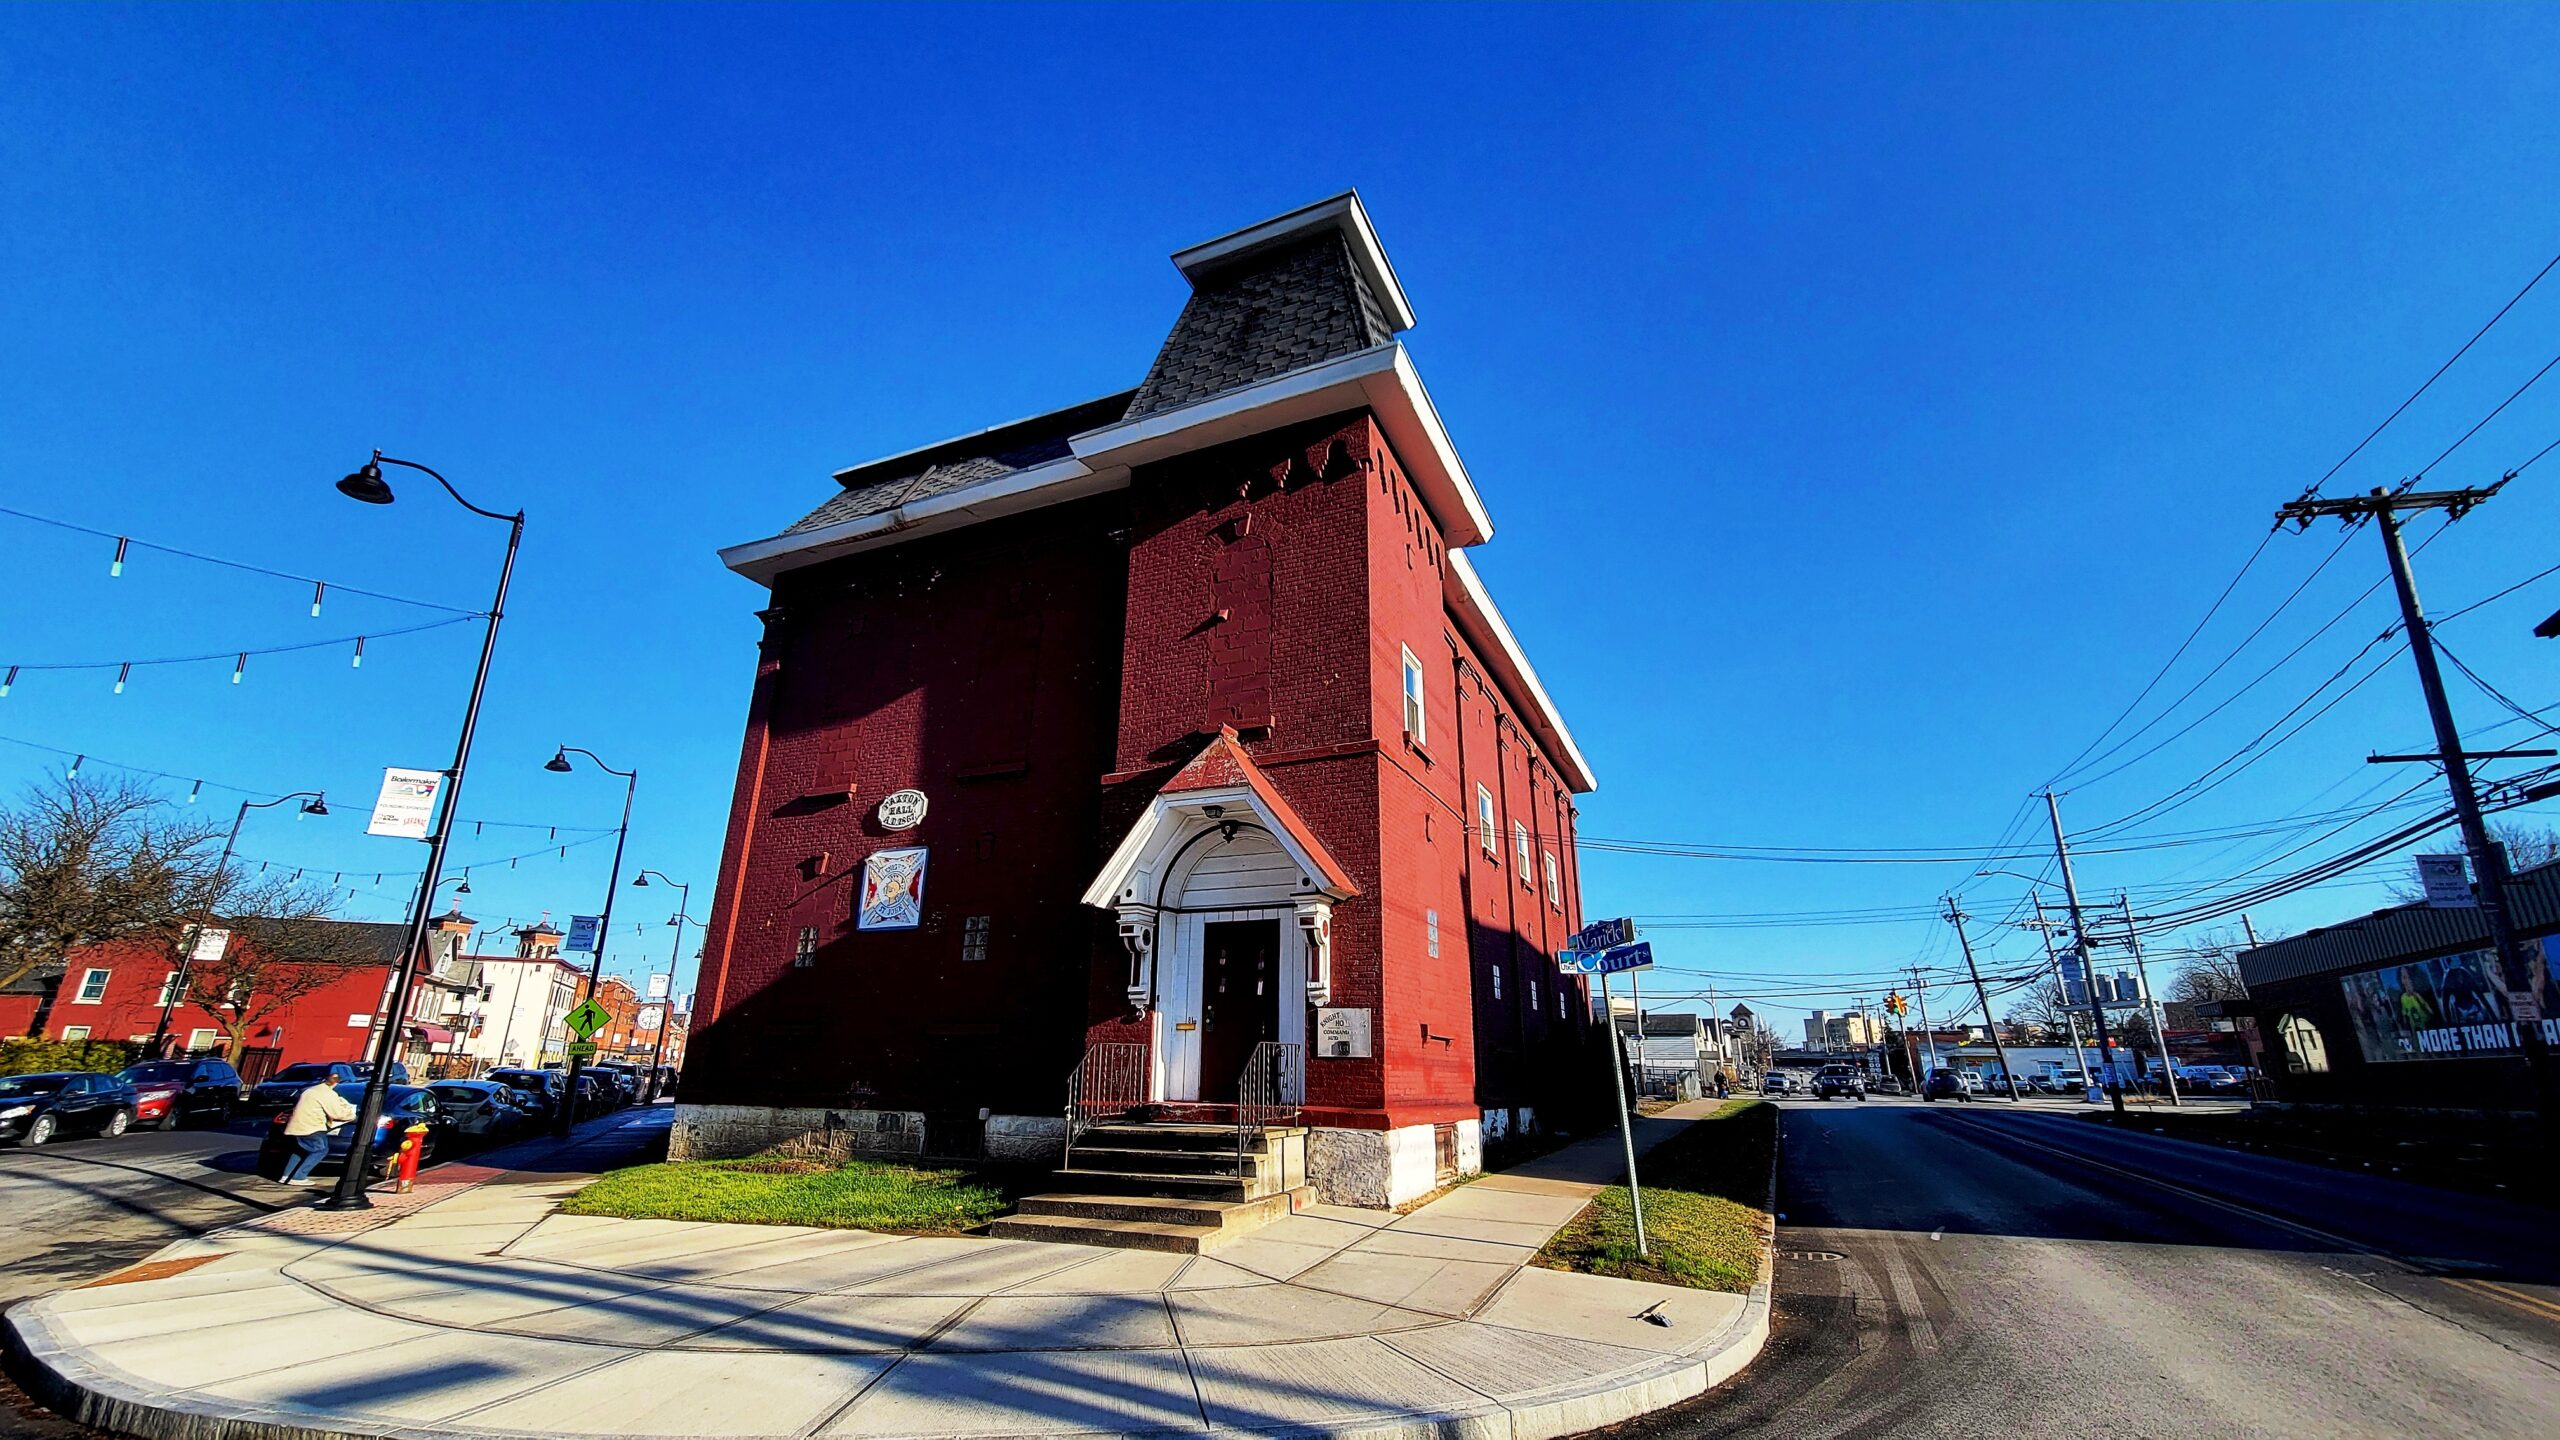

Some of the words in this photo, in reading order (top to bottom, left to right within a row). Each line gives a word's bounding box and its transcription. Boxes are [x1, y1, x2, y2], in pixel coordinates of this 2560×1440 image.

[1579, 923, 1620, 950] Varick
[1577, 949, 1643, 972] Court
[2417, 1027, 2462, 1053] MORE
[2461, 1023, 2510, 1050] THAN
